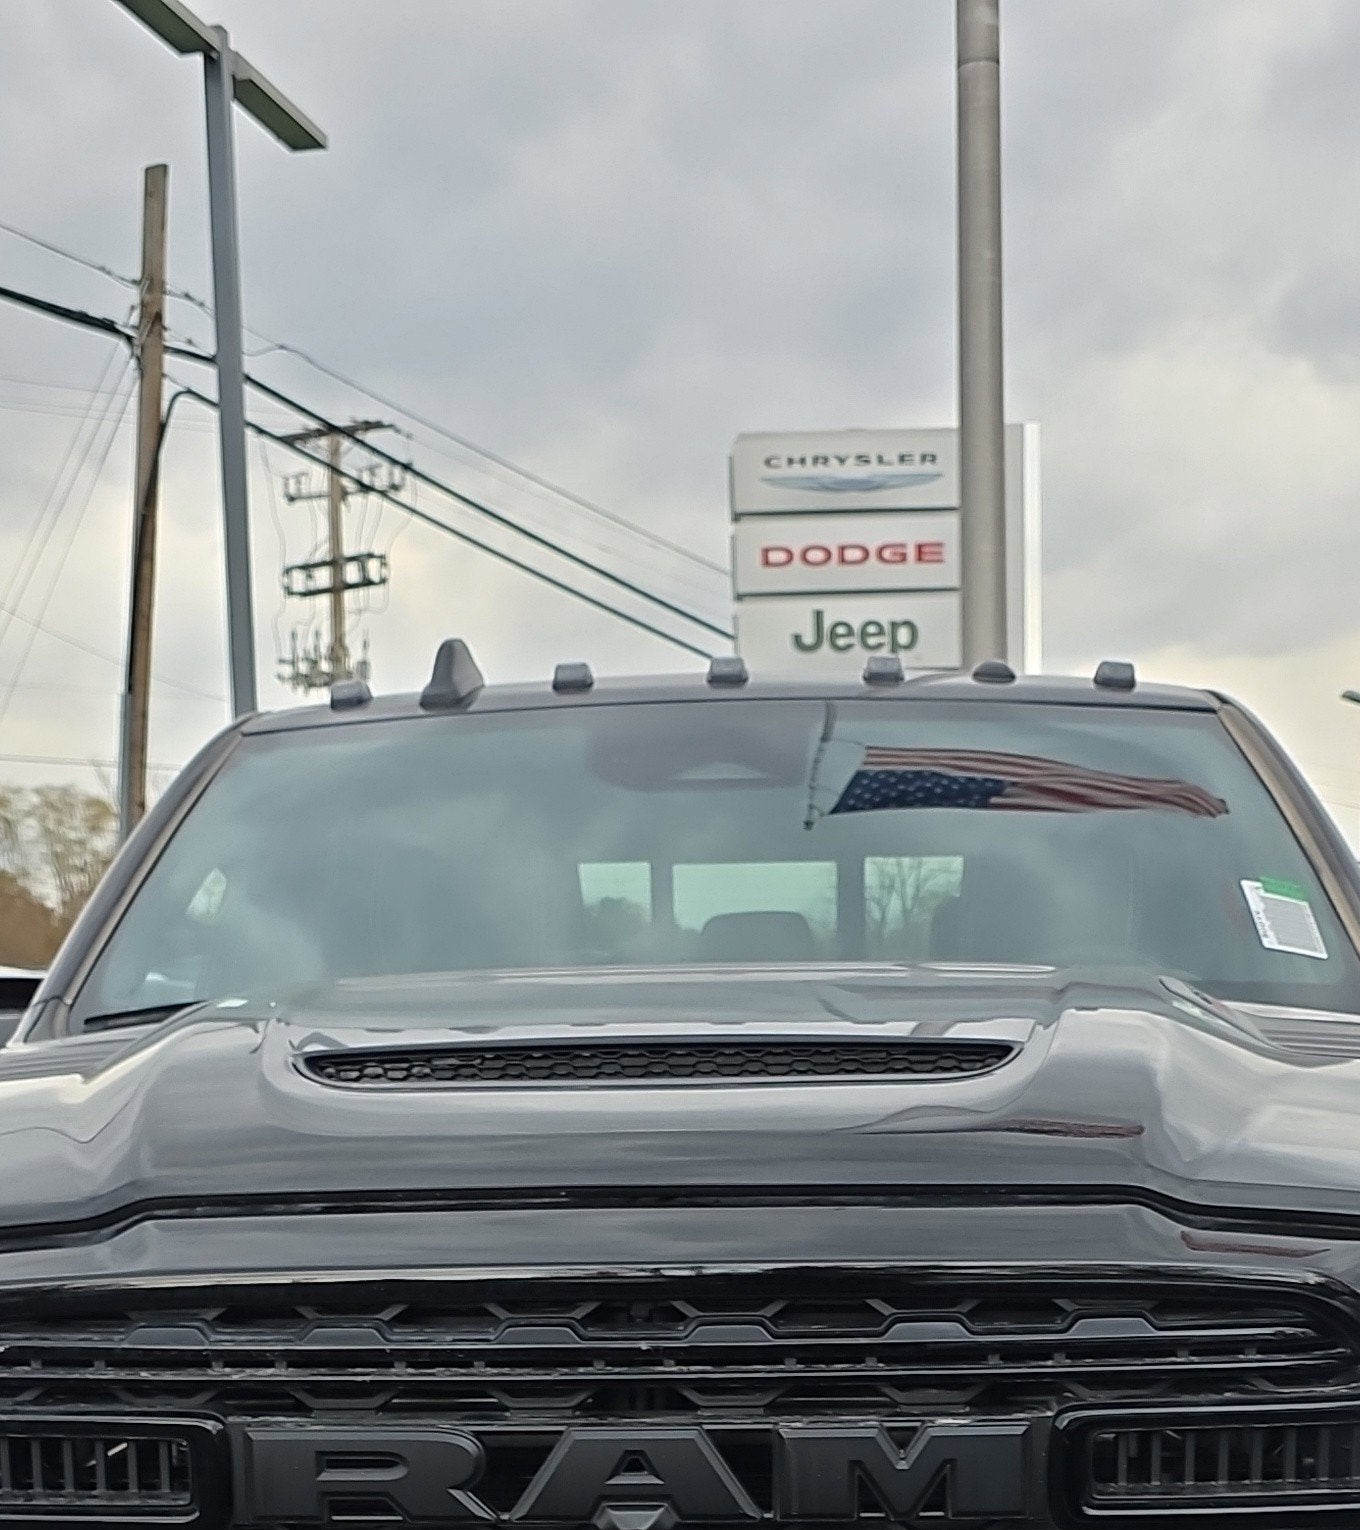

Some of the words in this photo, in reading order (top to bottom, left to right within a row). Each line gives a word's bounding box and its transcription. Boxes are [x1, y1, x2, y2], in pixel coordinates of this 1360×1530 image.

[763, 452, 939, 469] CHRYSLER
[761, 541, 945, 568] DODGE
[793, 609, 919, 653] Jeep
[244, 1424, 1032, 1522] RAM
